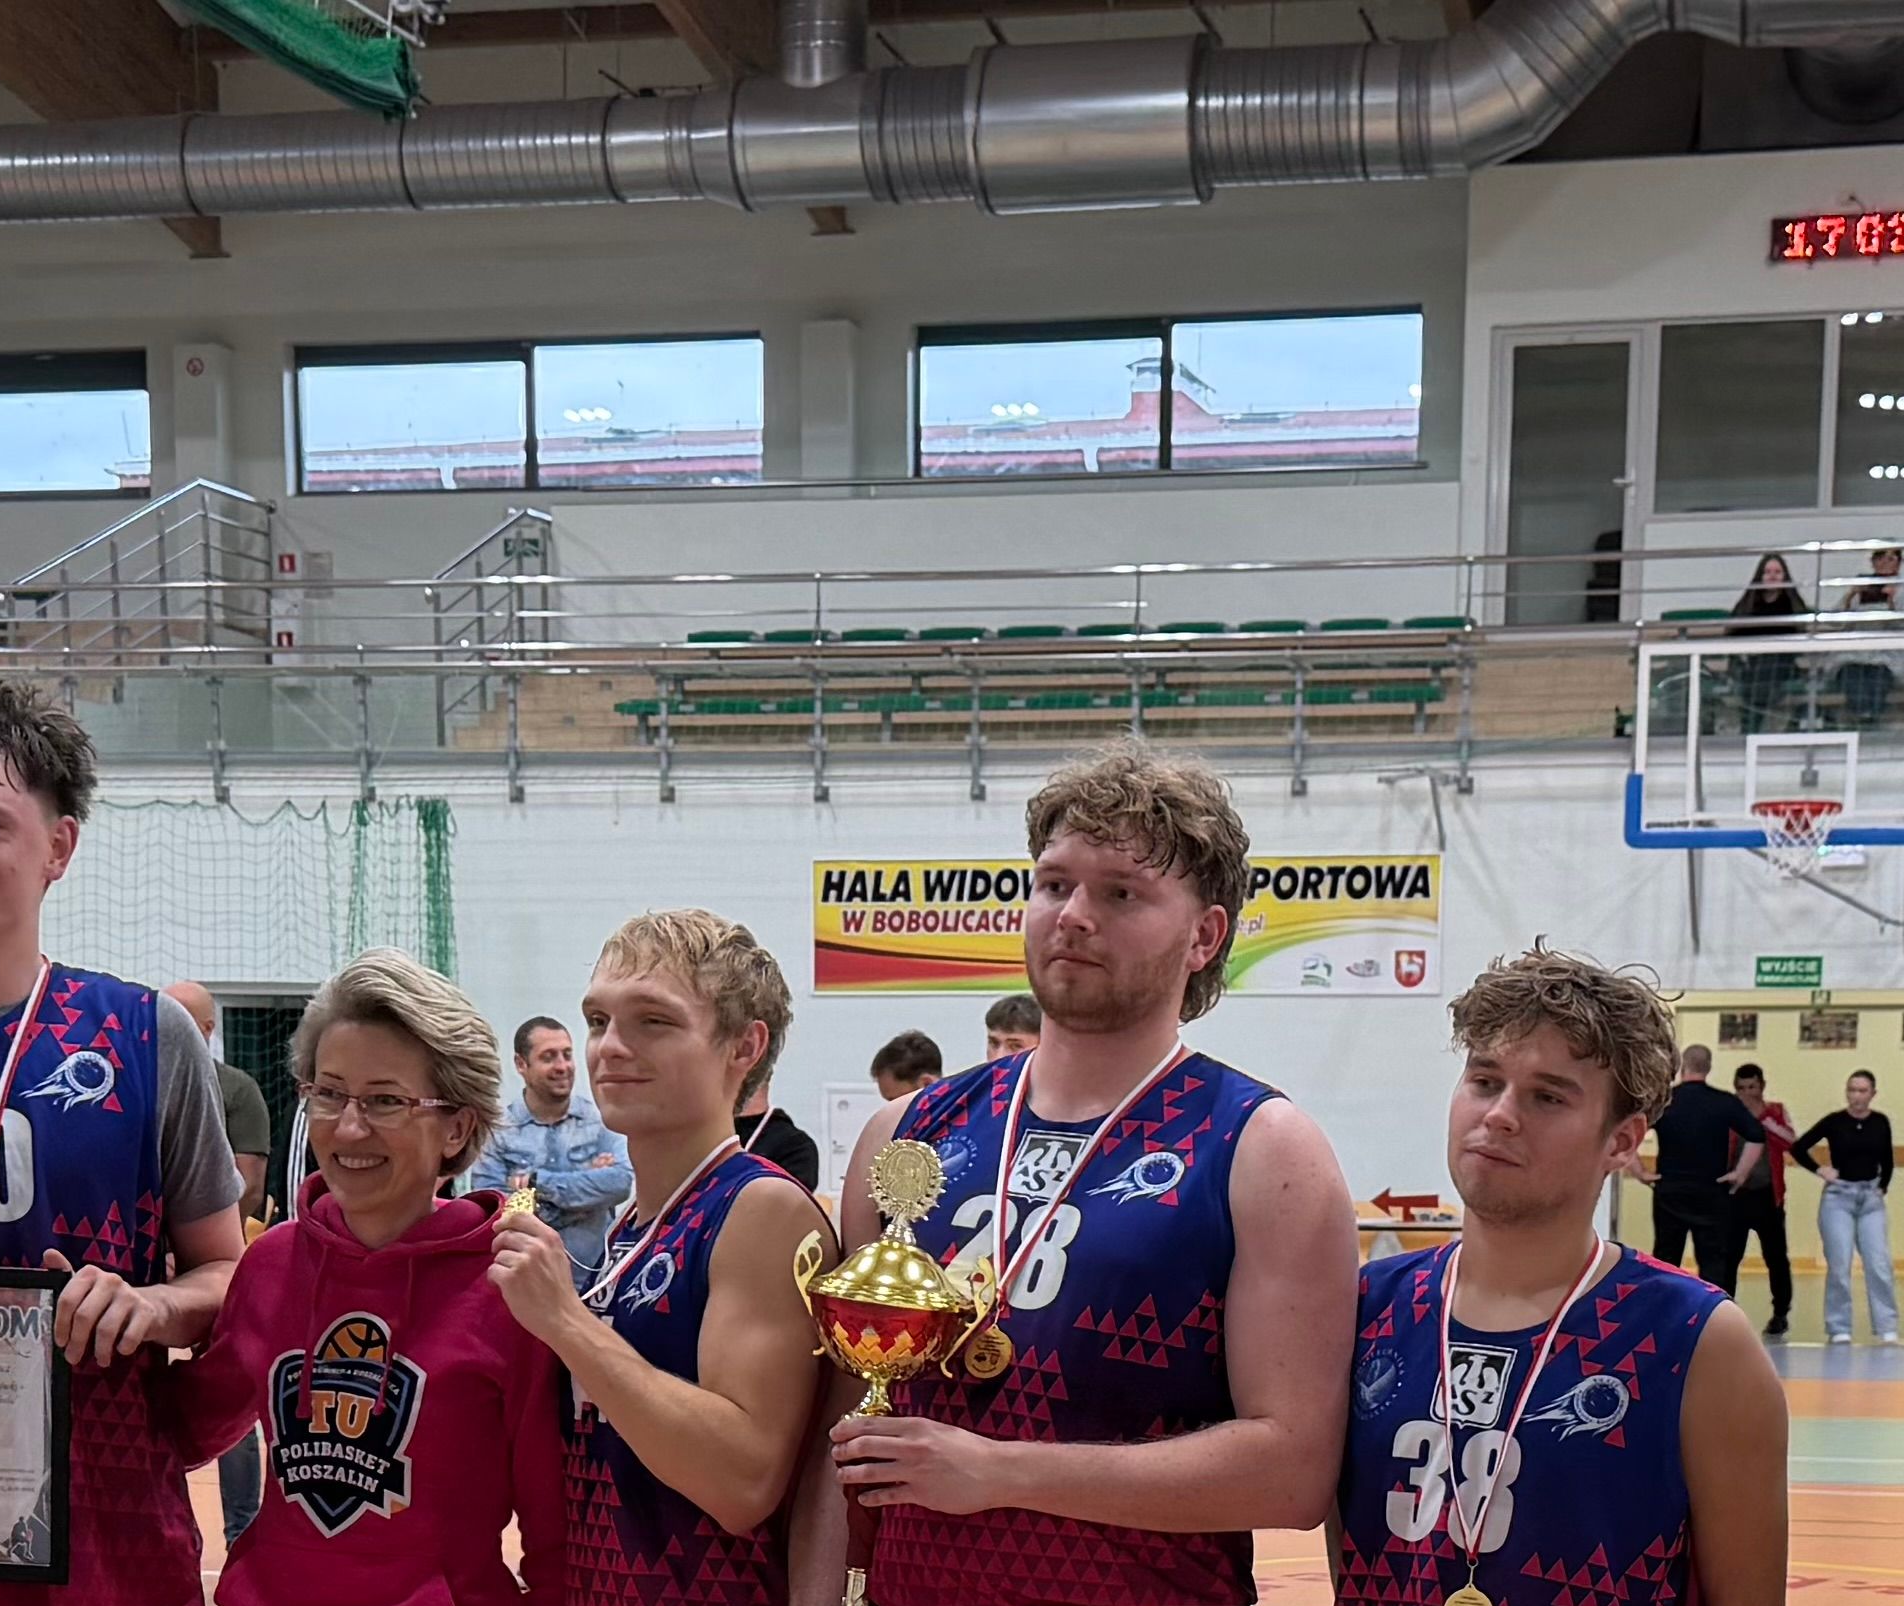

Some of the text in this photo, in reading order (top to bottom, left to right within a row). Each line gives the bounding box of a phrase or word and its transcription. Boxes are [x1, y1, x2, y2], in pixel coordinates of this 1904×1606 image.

[822, 870, 912, 903] HALA
[1250, 865, 1431, 900] PORTOWA
[843, 909, 1024, 934] W BOBOLICACH
[944, 1194, 1082, 1310] 28
[309, 1390, 376, 1439] TU
[280, 1441, 391, 1476] POLIBASKET
[286, 1463, 380, 1494] KOSZALIN
[1386, 1419, 1522, 1553] 38
